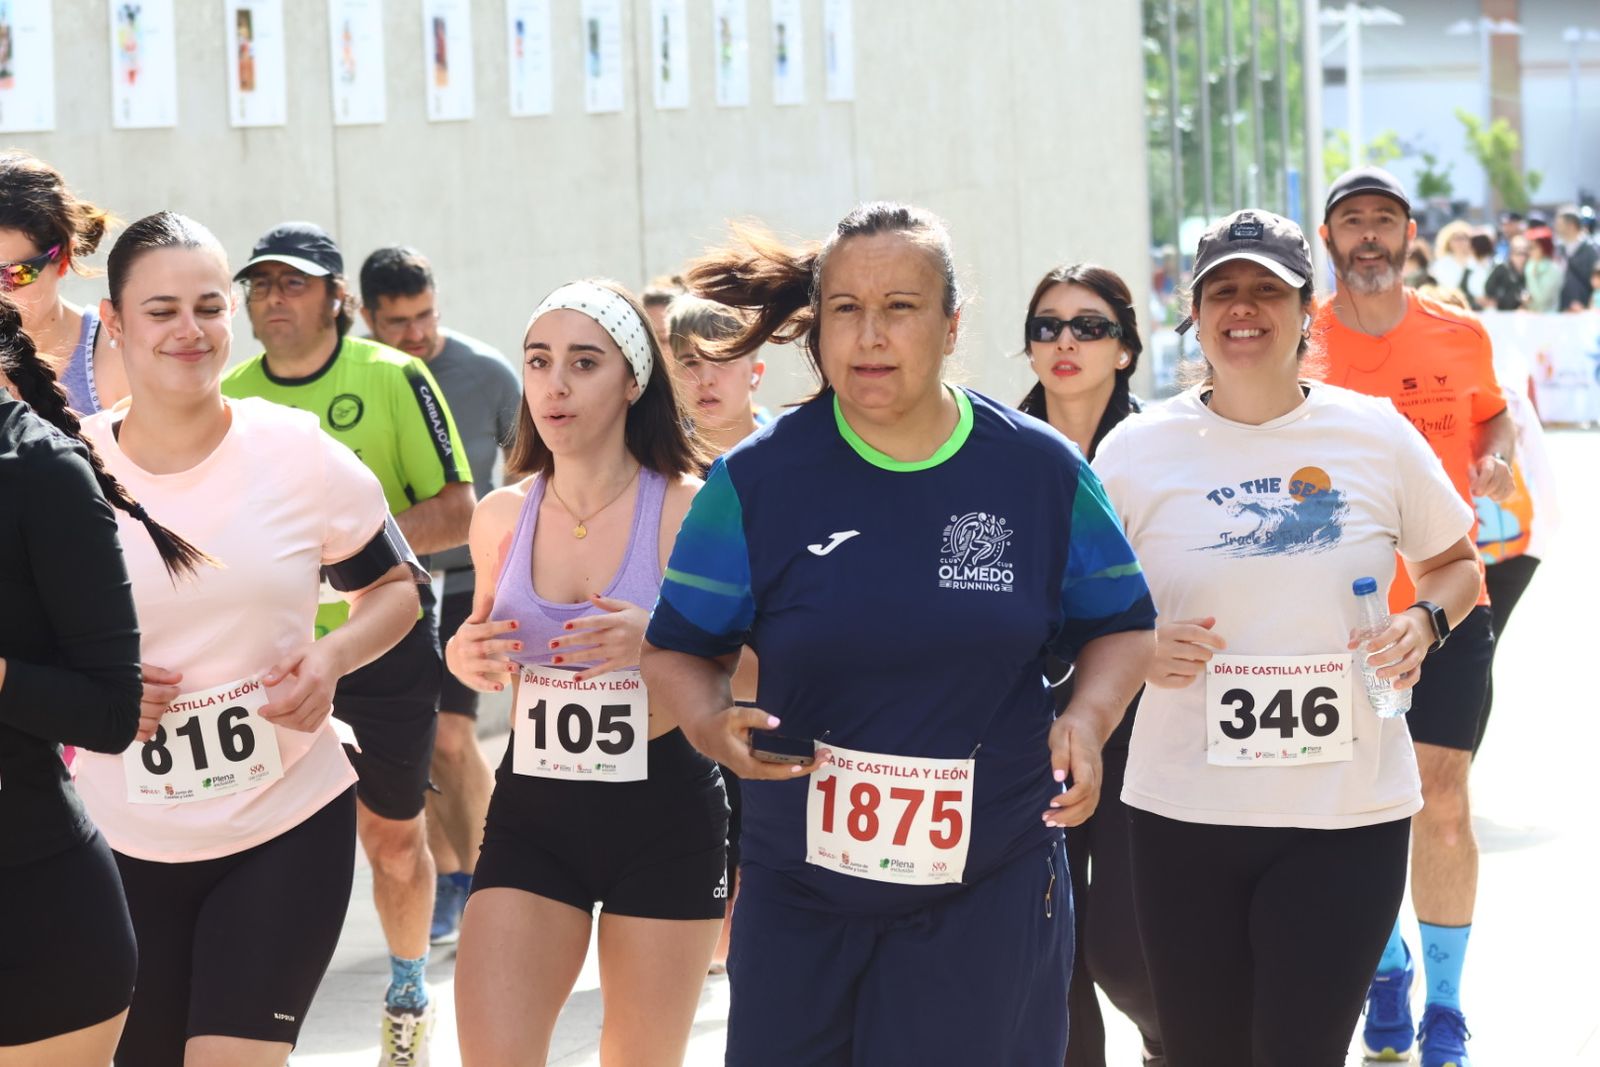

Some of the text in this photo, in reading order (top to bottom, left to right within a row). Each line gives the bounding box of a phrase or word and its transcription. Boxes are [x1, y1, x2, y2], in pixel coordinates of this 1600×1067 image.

[420, 386, 452, 456] CARBAJOSA
[1206, 487, 1235, 506] TO
[1240, 477, 1281, 494] THE
[1220, 531, 1260, 545] Track
[939, 565, 1014, 584] OLMEDO
[953, 581, 1000, 592] RUNNING
[1214, 661, 1344, 675] DÍA DE CASTILLA Y LEÓN
[525, 673, 639, 691] DÍA DE CASTILLA Y LEÓN
[164, 681, 260, 714] ASTILLA Y LEÓN
[1219, 686, 1340, 740] 346
[528, 699, 635, 755] 105
[142, 706, 255, 775] 816
[212, 773, 235, 783] Plena
[838, 757, 853, 770] DE
[857, 762, 919, 778] CASTILLA
[922, 768, 931, 779] Y
[934, 767, 968, 780] LEÓN
[816, 774, 963, 850] 1875
[891, 859, 914, 868] Plena
